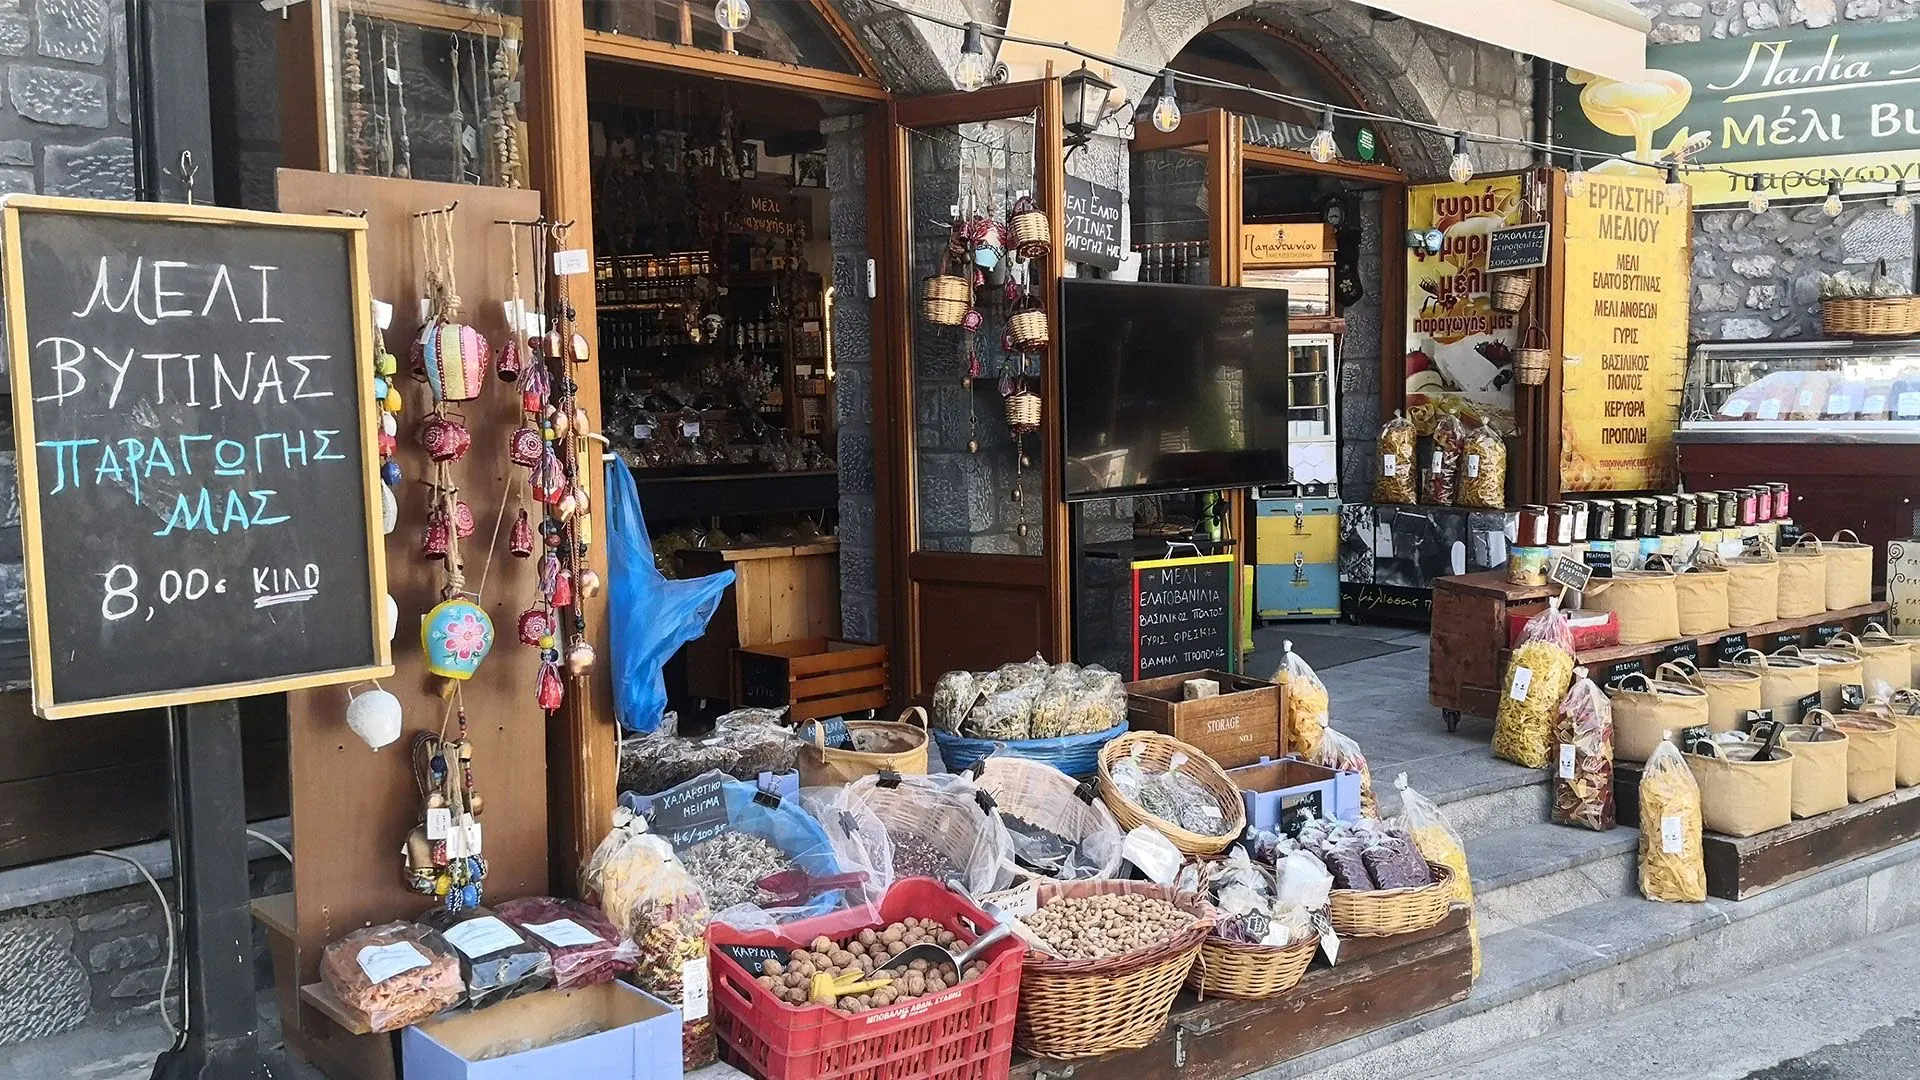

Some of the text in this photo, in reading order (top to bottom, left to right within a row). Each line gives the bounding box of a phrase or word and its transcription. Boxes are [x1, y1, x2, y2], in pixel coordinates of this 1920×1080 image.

[1721, 104, 1846, 149] Μέλι
[751, 196, 781, 213] Μέλι
[1435, 185, 1496, 221] τυριά
[1063, 213, 1115, 241] ΥΤΙΝΑΣ
[1492, 229, 1545, 242] ΣΟΚΟΛΑΤΕΣ
[1598, 213, 1660, 243] ΜΕΛΙΟΥ
[1616, 253, 1640, 272] ΜΕΛΙ
[72, 255, 285, 325] ΜΕΛΙ
[1437, 267, 1488, 301] μέλι
[1592, 271, 1661, 293] ΕΛΑΤΟ ΒΥΤΙΝΑΣ
[1594, 299, 1658, 320] ΜΕΛΙ ΑΝΘΕΩΝ
[1414, 310, 1514, 337] παραγωγής μας
[1613, 327, 1639, 345] ΓΥΡΙΣ
[35, 337, 335, 410] ΒΥΤΙΝΑΣ
[1601, 354, 1650, 372] ΒΑΣΙΛΙΚΟΣ
[1607, 373, 1643, 391] ΠΟΛΤΟΣ
[1604, 400, 1646, 418] ΚΕΡΥΘΡΑ
[1601, 426, 1648, 445] ΠΡΟΠΟΛΗ
[153, 489, 291, 536] ΜΑΣ
[252, 563, 320, 599] ΚΙΛΟ
[1161, 567, 1198, 585] ΜΕΛΙ
[1139, 588, 1221, 607] ΕΛΑΤΟΒΑΝΙΛΙΑ
[1139, 606, 1224, 627] ΒΑΣΙΛΙΚΟΣ ΠΟΛΤΟΣ
[1140, 627, 1217, 647] ΓΥΡΙΣ ΦΡΕΣΚΙΑ
[1206, 715, 1240, 734] STORAGE
[683, 796, 720, 818] ΜΕΙΓΜΑ
[732, 946, 779, 959] ΚΑΡΥΔΙΑ
